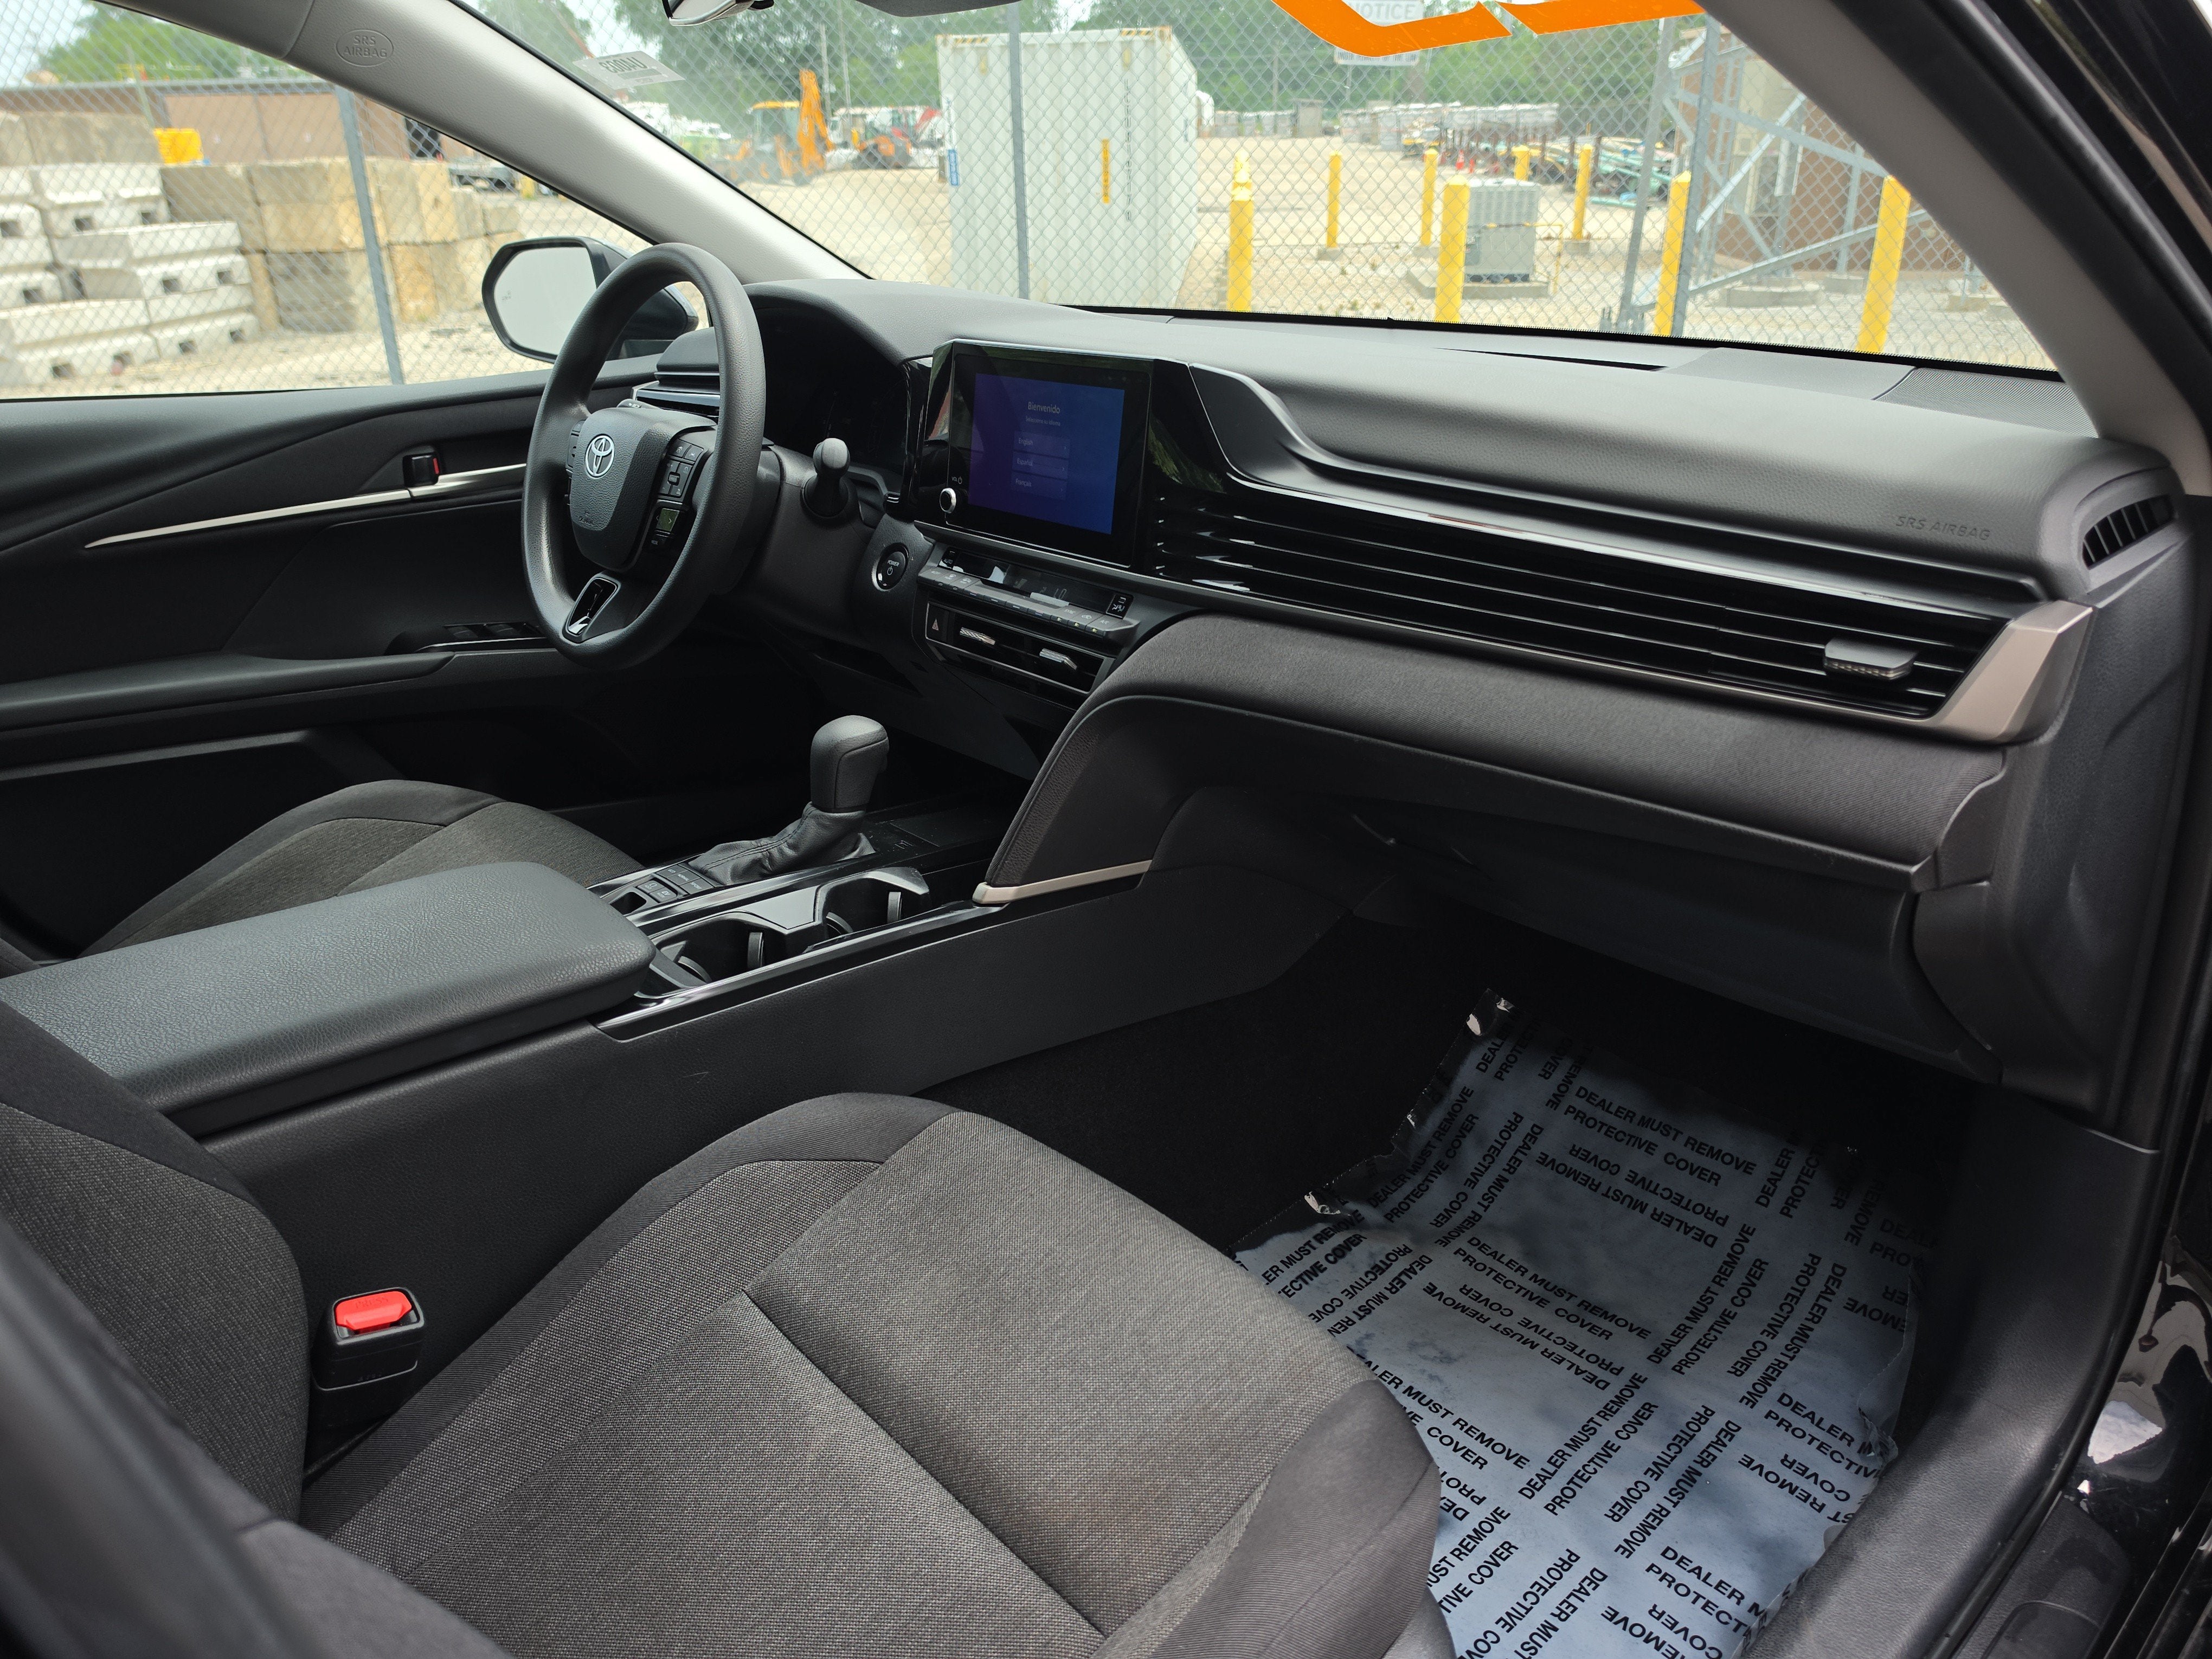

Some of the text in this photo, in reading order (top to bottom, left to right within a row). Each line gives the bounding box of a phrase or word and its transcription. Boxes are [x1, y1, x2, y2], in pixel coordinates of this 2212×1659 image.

[343, 46, 387, 58] AIRBAG
[353, 35, 376, 46] SRS
[1028, 402, 1060, 414] Bienvenido
[1895, 516, 1991, 541] SRS AIRBAG
[1476, 1022, 1514, 1073] DEALER
[1538, 1037, 1573, 1080] COVER
[1545, 1054, 1587, 1110] REMOVE
[1367, 1171, 1410, 1209] DEALER
[1406, 1140, 1437, 1180] MUST
[1432, 1086, 1475, 1142] REMOVE
[1384, 1160, 1450, 1223] PROTECTIVE
[1445, 1113, 1480, 1159] COVER
[1429, 1111, 1524, 1229] PROTECTIVE COVER
[1564, 1104, 1722, 1187] PROTECTIVE COVER
[1574, 1085, 1637, 1124] DEALER
[1637, 1115, 1683, 1142] MUST
[1683, 1135, 1757, 1176] REMOVE
[1435, 1123, 1545, 1248] DEALER MUST REMOVE
[1535, 1151, 1719, 1248] DEALER MUST REMOVE
[1569, 1143, 1729, 1227] PROTECTIVE COVER
[1754, 1147, 1796, 1208] DEALER
[1278, 1261, 1328, 1298] ECTIVE
[1324, 1233, 1367, 1264] COVER
[1279, 1240, 1316, 1269] MUST
[1313, 1209, 1365, 1245] REMOVE
[1384, 1253, 1433, 1296] DEALER
[1308, 1244, 1413, 1323] PROTECTIVE COVE
[1352, 1291, 1390, 1321] MUST
[1453, 1247, 1614, 1341] PROTECTIVE COVER
[1467, 1236, 1652, 1340] DEALER MUST REMOVE
[1647, 1223, 1757, 1365] DEALER MUST REMOVE
[1671, 1257, 1770, 1375] PROTECTIVE COVER
[1727, 1252, 1822, 1377] PROTECTIVE COVER
[1423, 1282, 1611, 1391] DEALER MUST REMOVE
[1459, 1283, 1625, 1376] PROTECTIVE COVER
[1738, 1262, 1848, 1409] DEALER MUST REMOVE
[1402, 1385, 1454, 1420] MUST
[1452, 1417, 1531, 1470] REMOVE
[1426, 1426, 1488, 1470] COVER
[1518, 1372, 1648, 1500] DEALER MUST REMOVE
[1544, 1401, 1659, 1516] PROTECTIVE COVER
[1764, 1409, 1878, 1478] PROTECTIV
[1777, 1392, 1855, 1448] DEALER
[1604, 1404, 1716, 1522] PROTECTIVE COVER
[1613, 1420, 1742, 1559] DEALER MUST REMOVE
[1738, 1454, 1826, 1514] REMOVE
[1779, 1453, 1850, 1502] COVER
[1425, 1556, 1456, 1587] UST
[1450, 1506, 1511, 1561] REMOVE
[1468, 1540, 1519, 1585] COVER
[1660, 1546, 1745, 1606] DEALER
[1494, 1548, 1581, 1634] PROTECTIVE
[1549, 1567, 1608, 1622] DEALER
[1648, 1603, 1723, 1659] COVER
[1600, 1605, 1685, 1659] EMOVE
